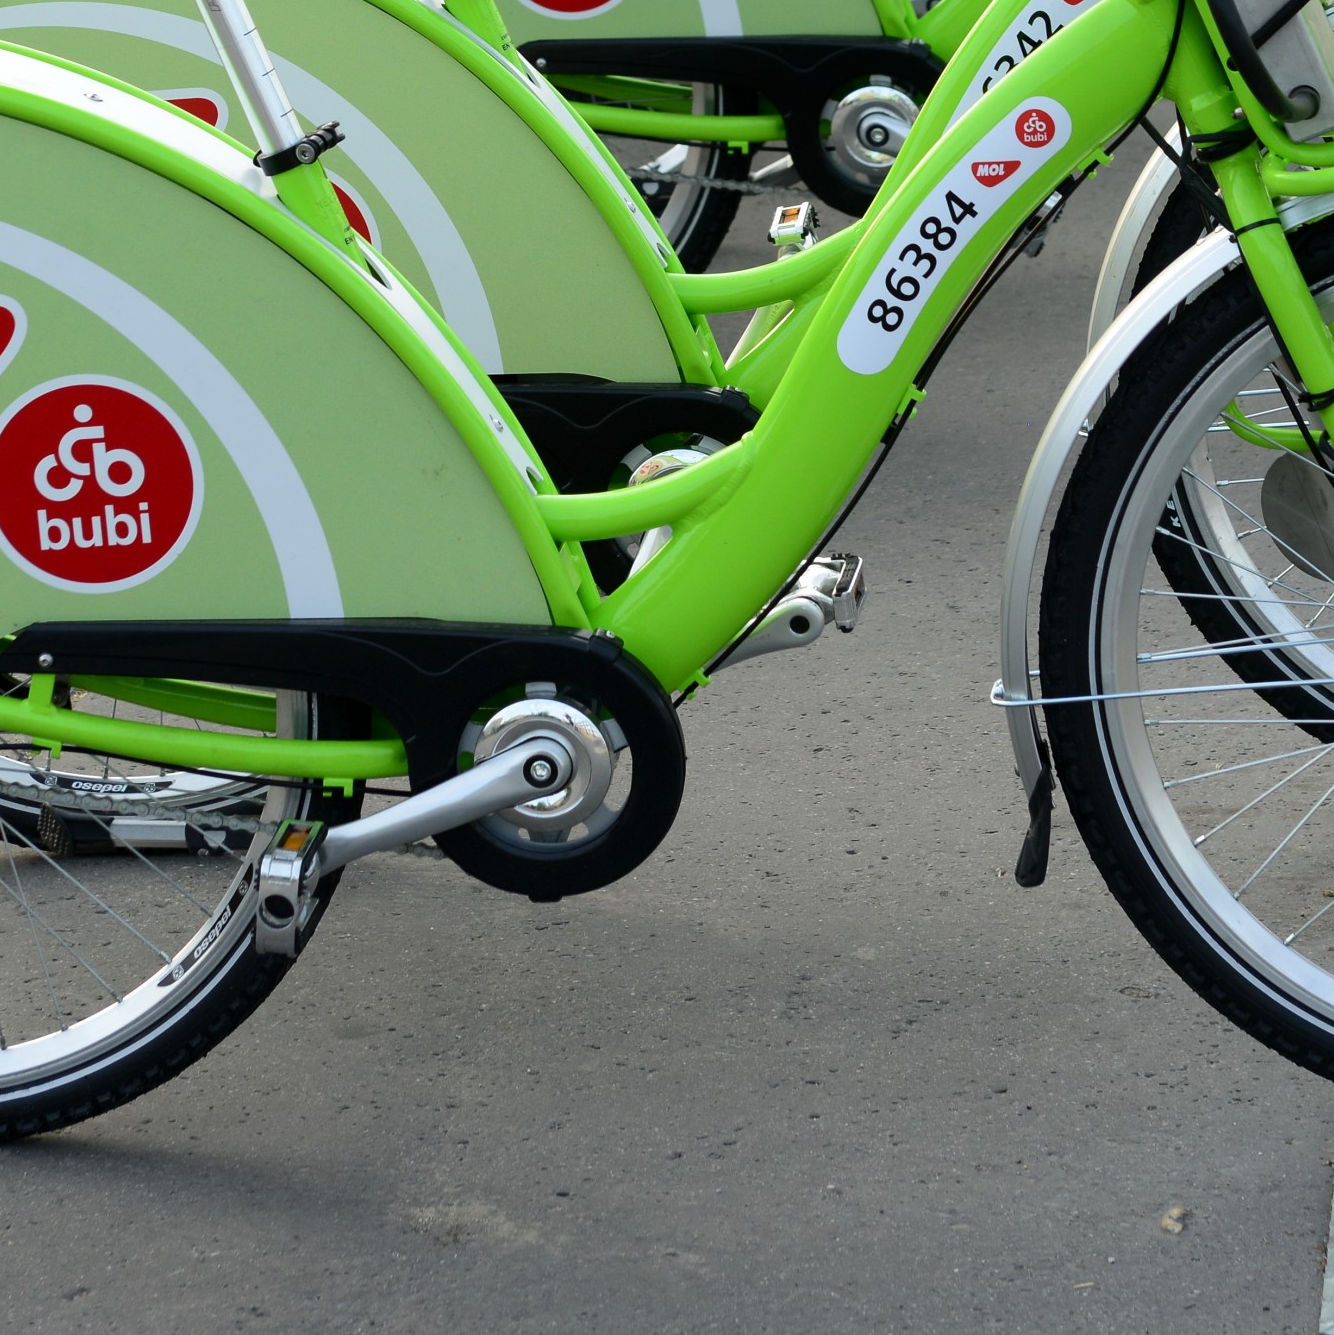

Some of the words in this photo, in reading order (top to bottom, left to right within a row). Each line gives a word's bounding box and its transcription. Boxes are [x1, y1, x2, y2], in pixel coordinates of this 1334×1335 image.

[1023, 132, 1048, 142] bubi
[976, 163, 1005, 177] MOL
[867, 190, 978, 333] 86384
[36, 502, 152, 551] bubi
